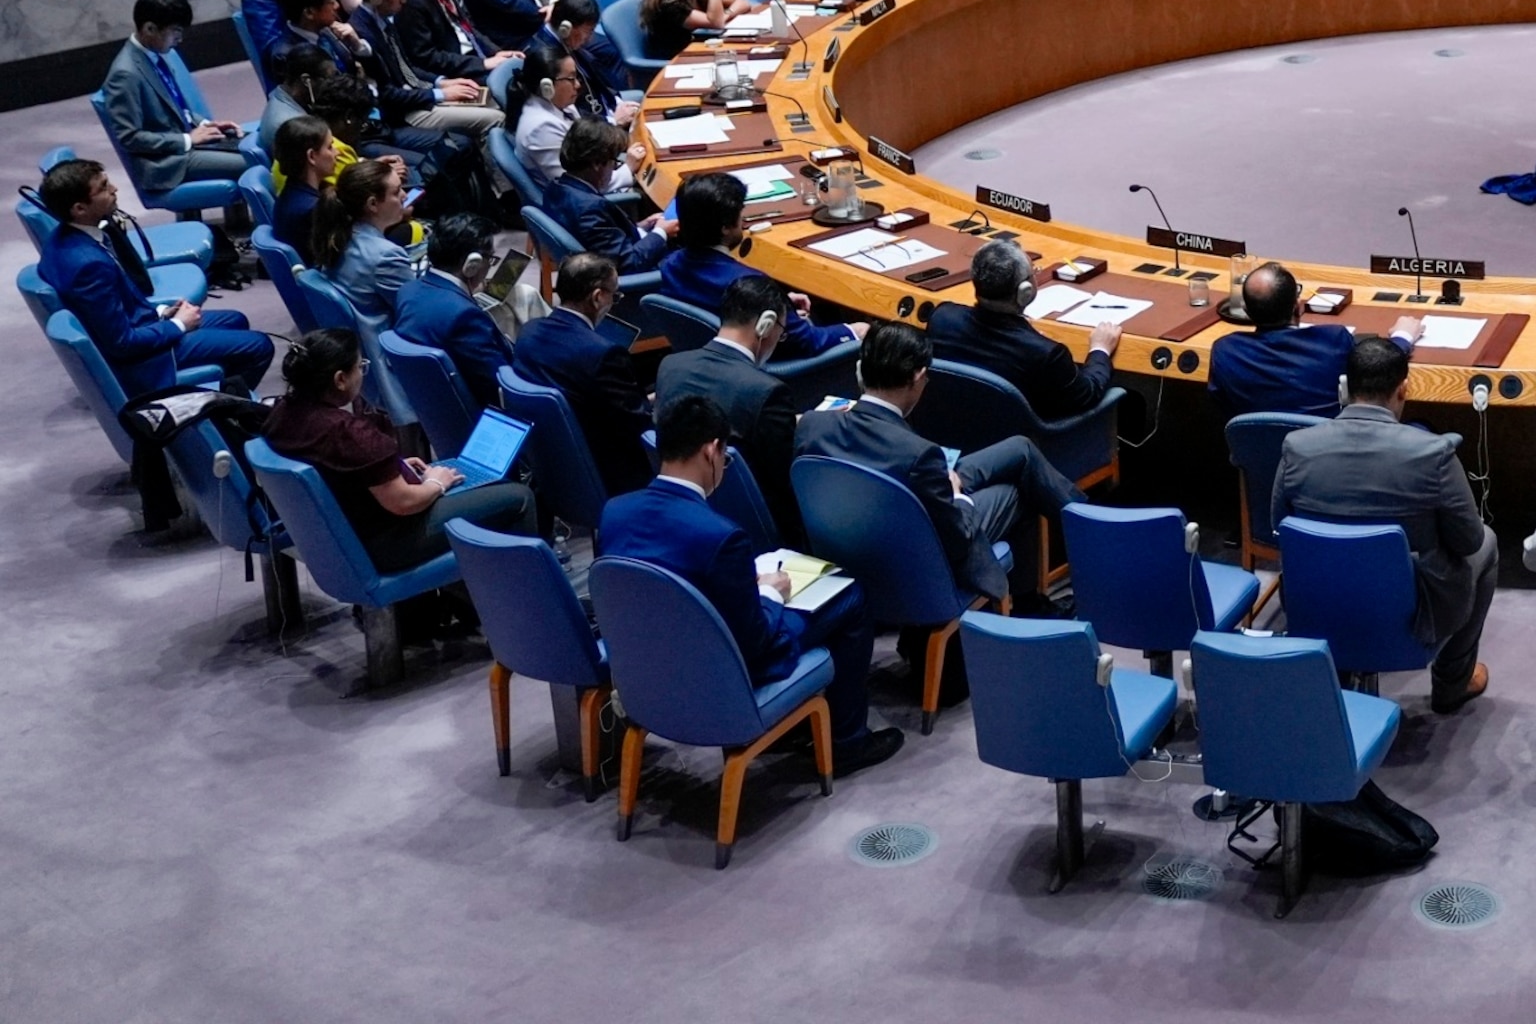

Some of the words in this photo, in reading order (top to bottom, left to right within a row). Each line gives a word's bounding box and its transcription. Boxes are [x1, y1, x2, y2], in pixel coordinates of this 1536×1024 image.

[870, 1, 887, 17] MALTA
[877, 144, 900, 166] FRANCE
[990, 191, 1033, 214] ECUADOR
[1176, 233, 1213, 251] CHINA
[1388, 258, 1466, 275] ALGERIA
